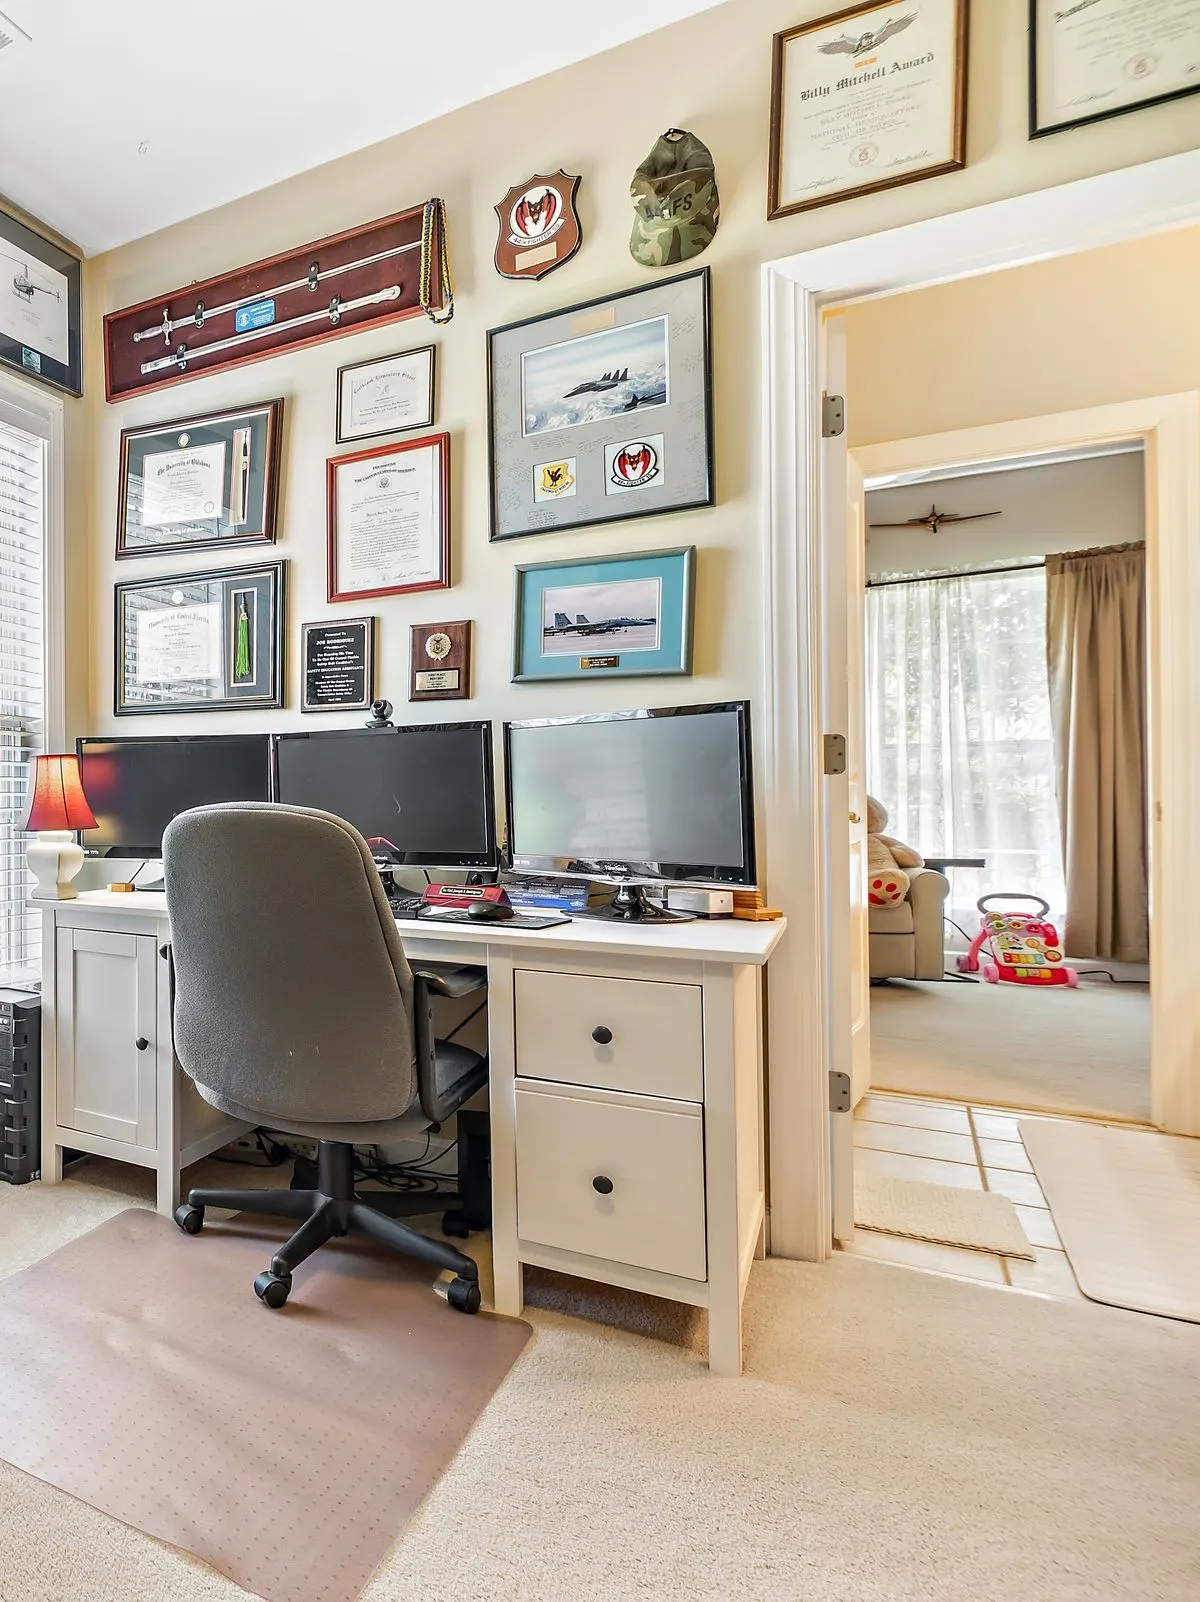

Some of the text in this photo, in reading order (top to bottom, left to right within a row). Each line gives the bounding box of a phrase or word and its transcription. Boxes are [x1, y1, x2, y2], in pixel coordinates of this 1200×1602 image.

[800, 86, 830, 102] Billy
[836, 67, 886, 92] Mitchell
[890, 52, 935, 74] Award
[165, 461, 186, 472] University
[191, 458, 211, 468] Oklahoma
